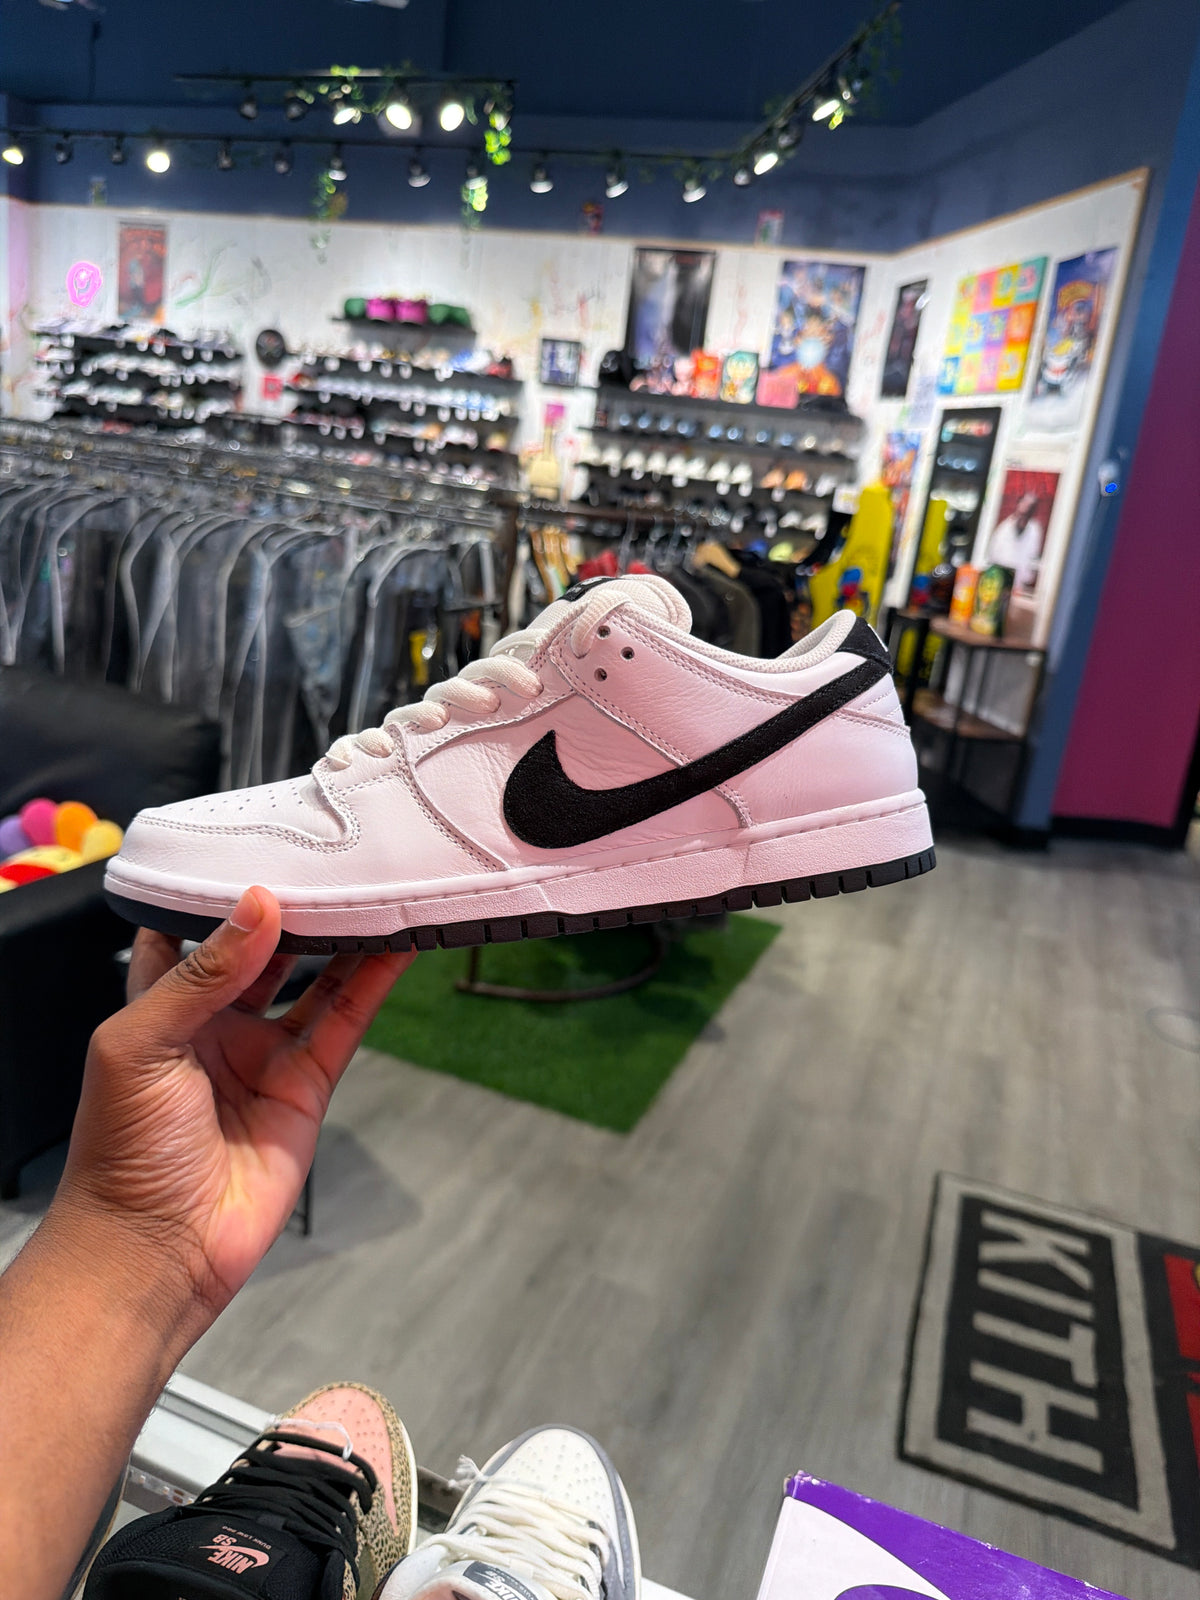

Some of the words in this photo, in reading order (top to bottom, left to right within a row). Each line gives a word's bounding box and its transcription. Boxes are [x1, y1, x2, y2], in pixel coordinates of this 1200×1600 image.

[966, 1210, 1104, 1474] KITH
[212, 1534, 237, 1546] SB
[207, 1548, 254, 1574] NIKE
